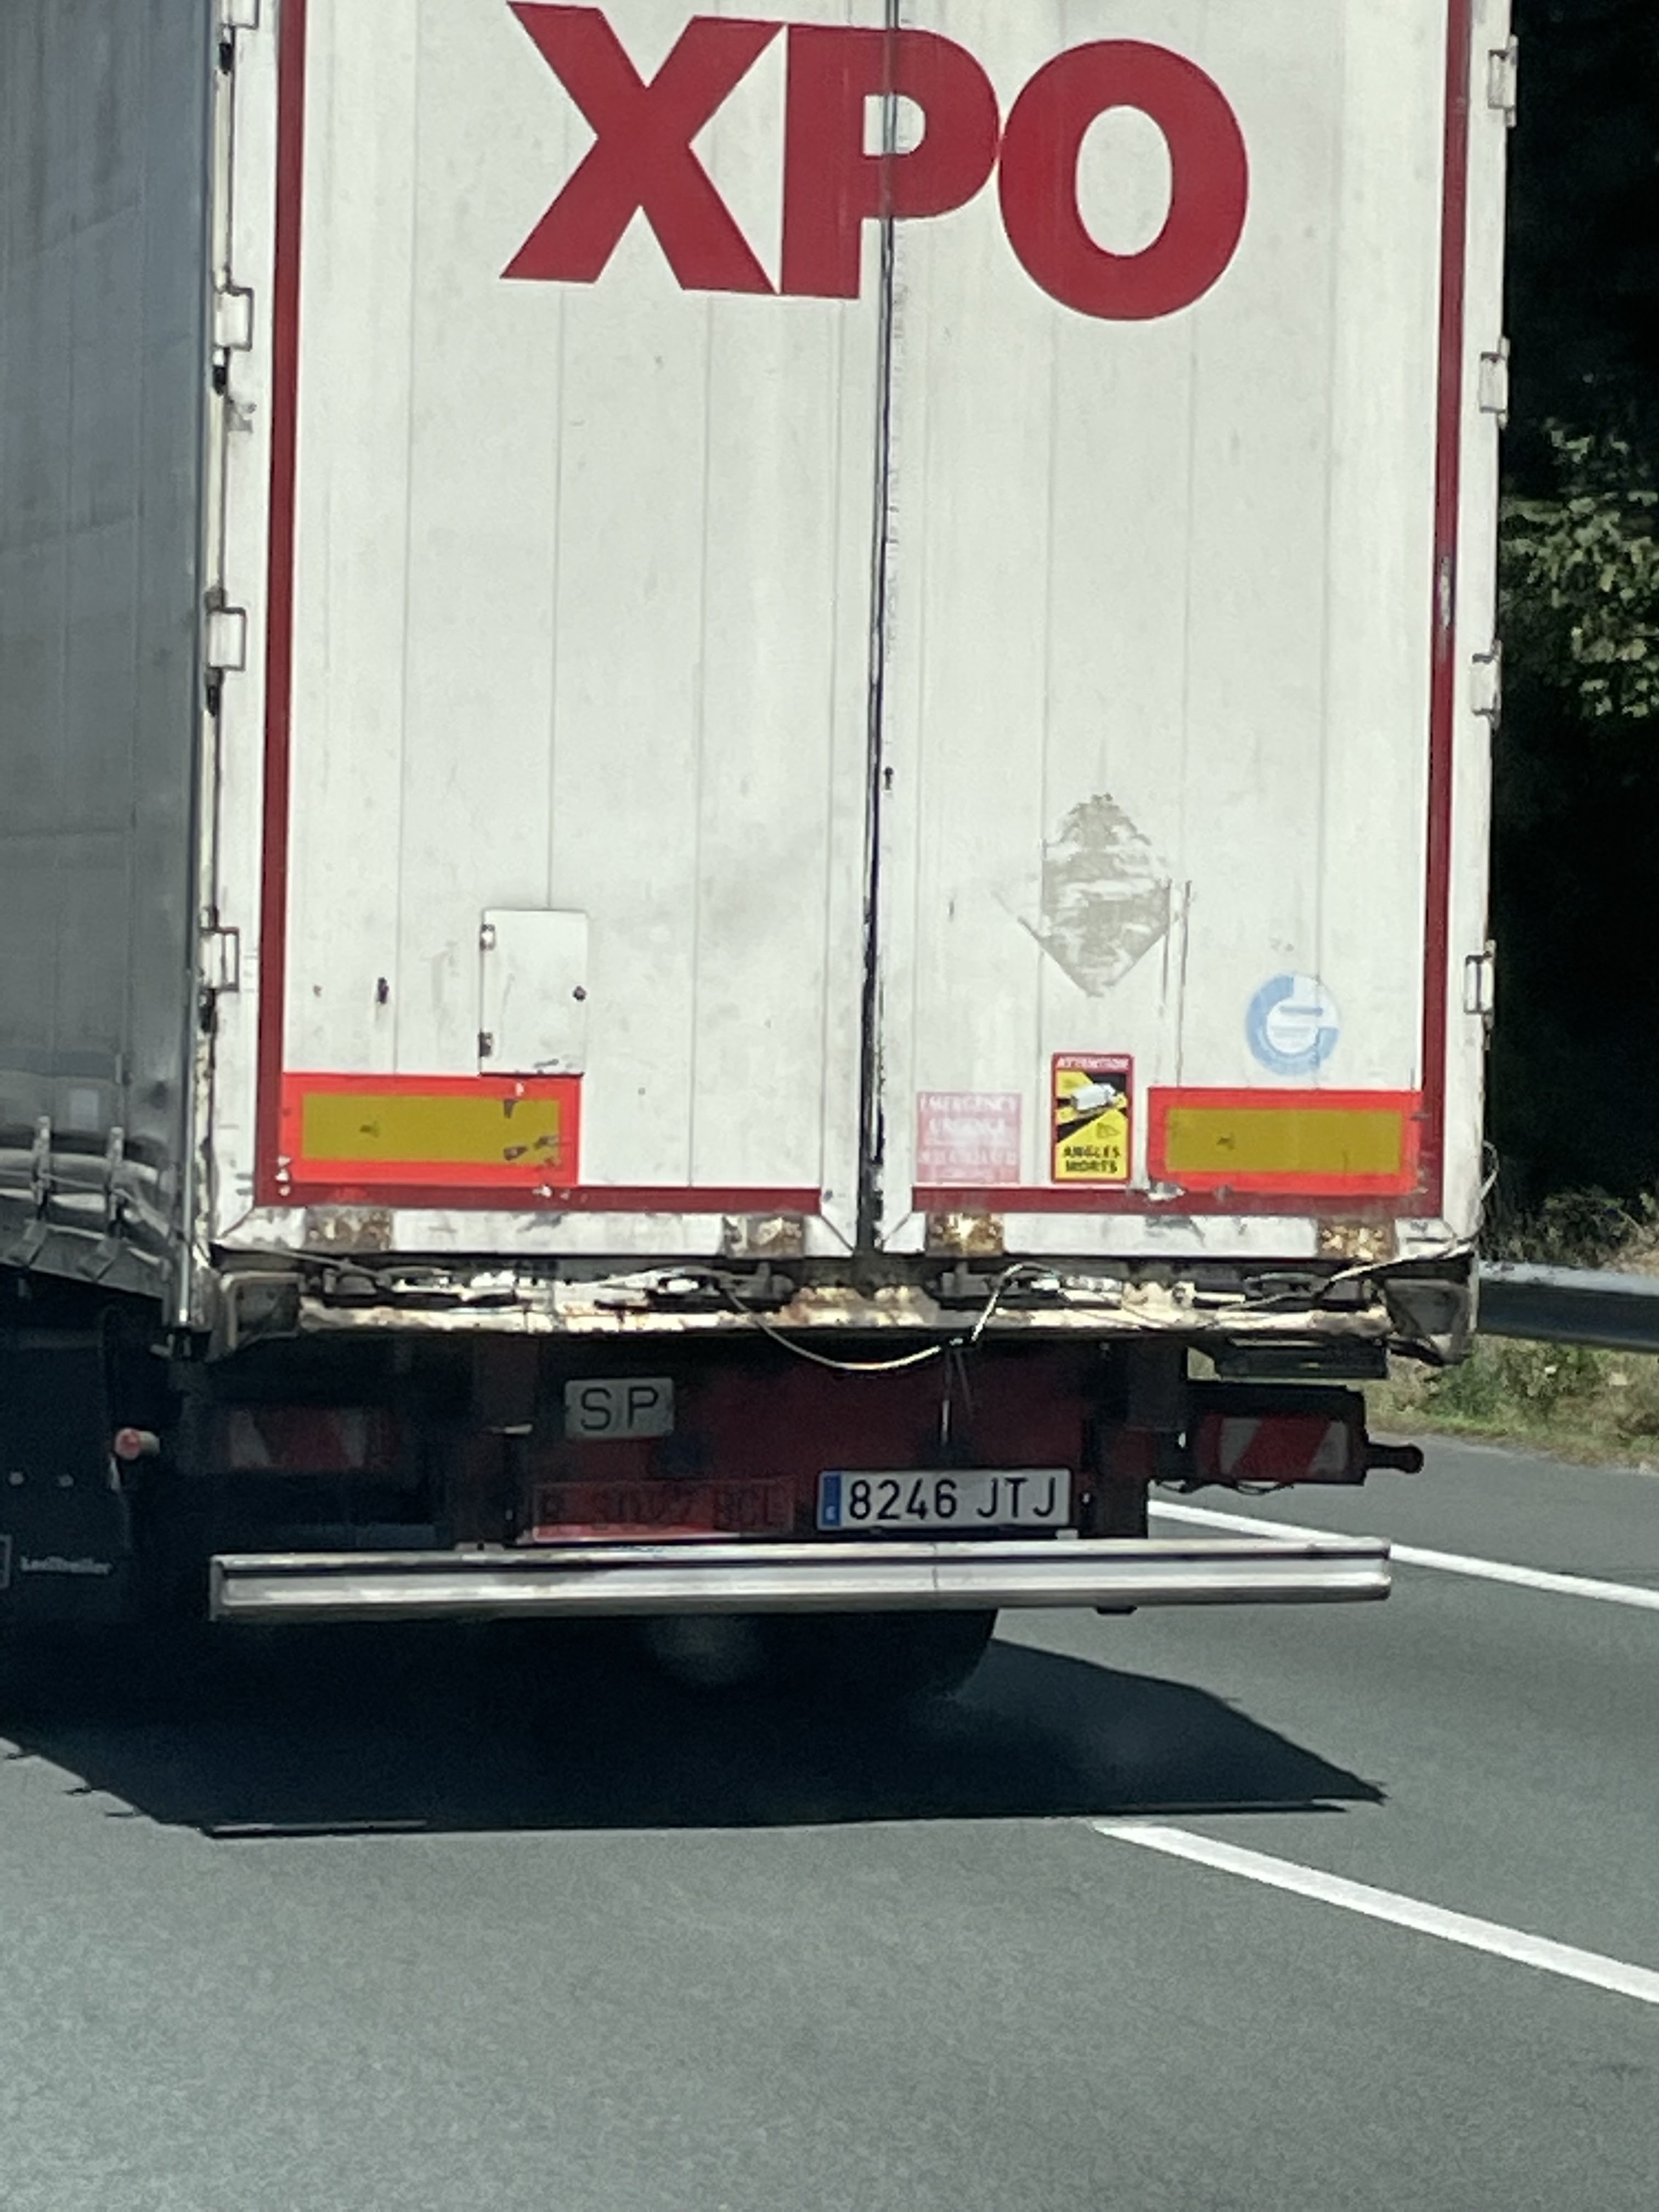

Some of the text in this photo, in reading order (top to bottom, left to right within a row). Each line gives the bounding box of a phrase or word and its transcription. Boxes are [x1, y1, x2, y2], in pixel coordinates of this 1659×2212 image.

[500, 1, 1249, 321] XPO
[580, 1386, 658, 1431] SP
[849, 1477, 1056, 1521] 8246 JTJ
